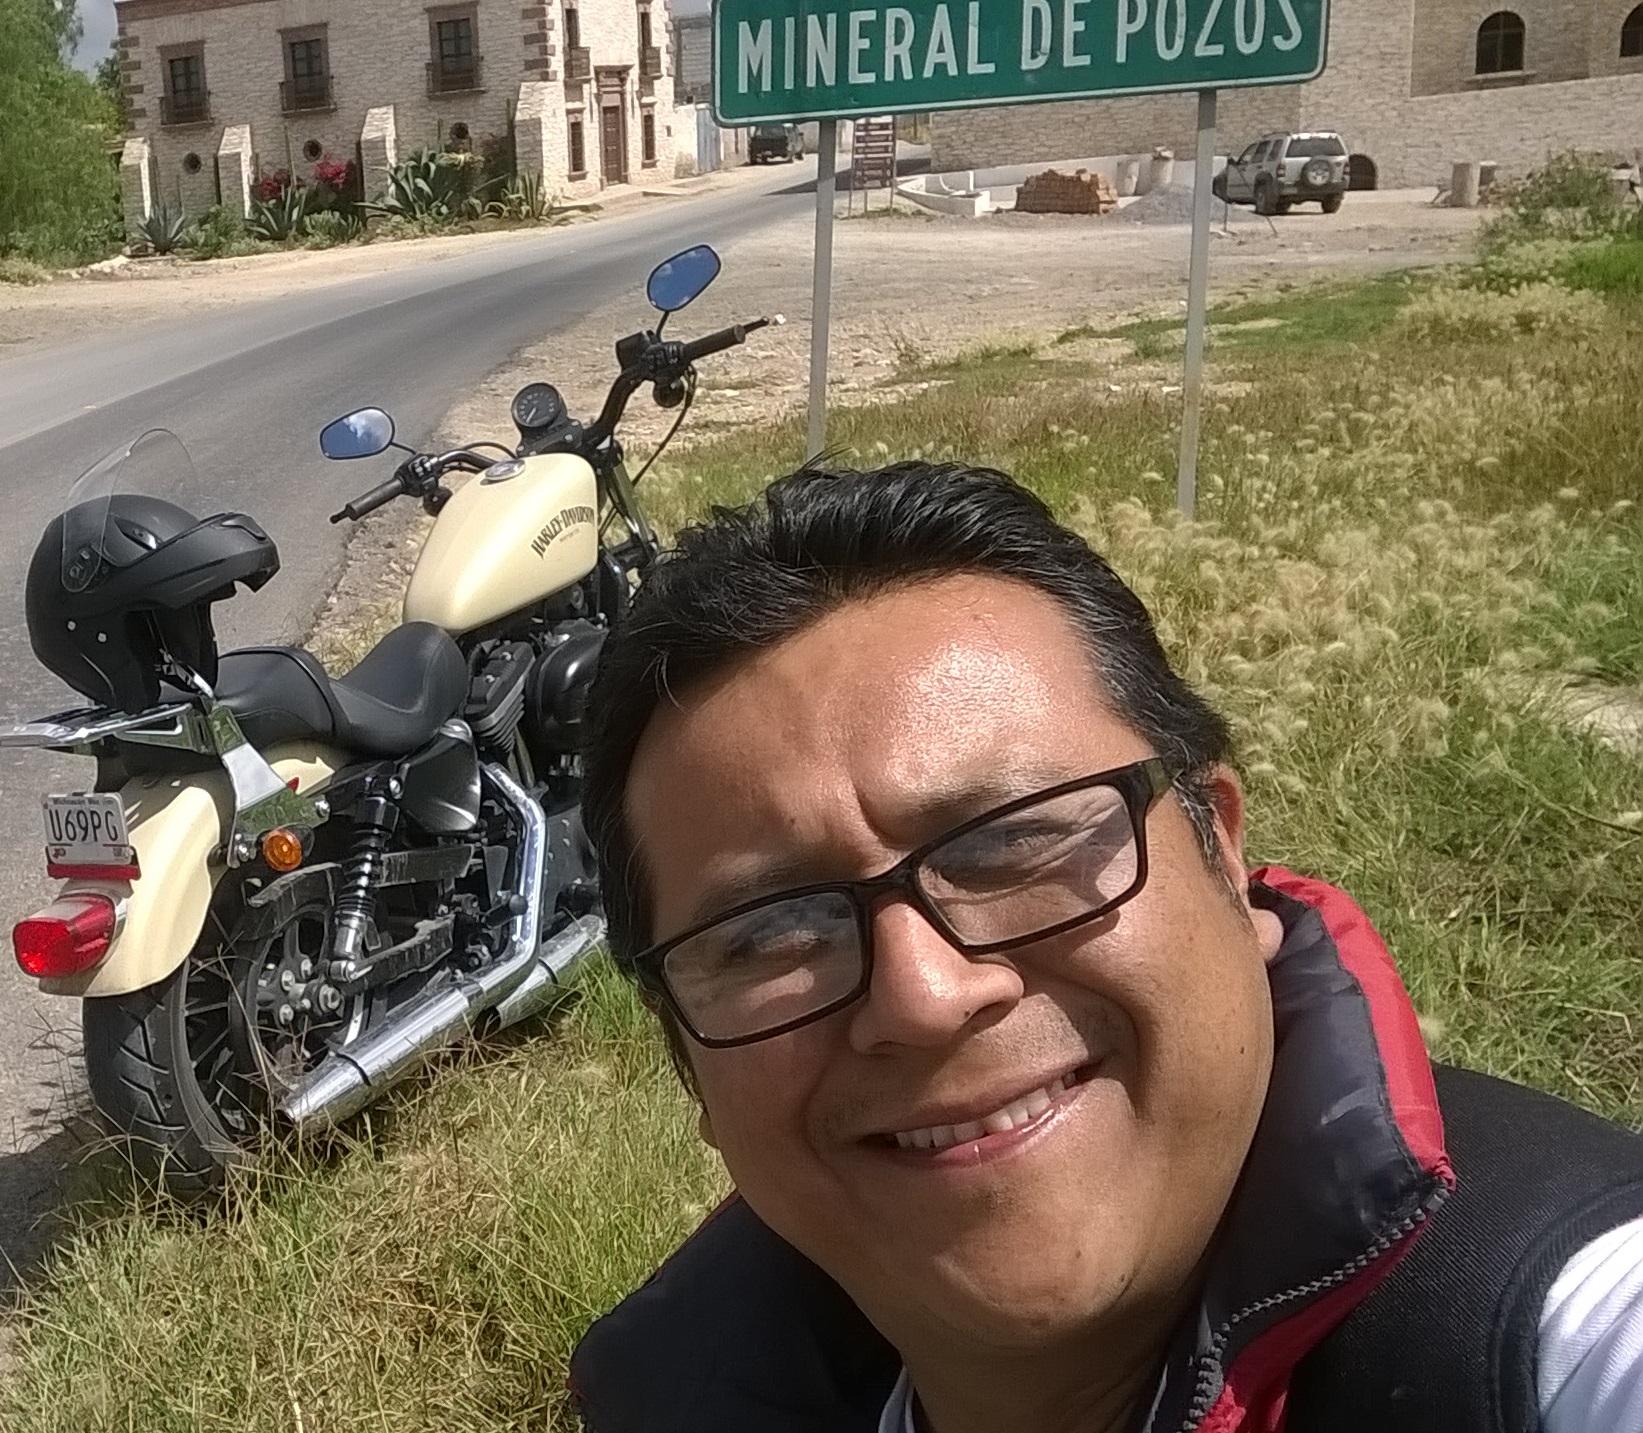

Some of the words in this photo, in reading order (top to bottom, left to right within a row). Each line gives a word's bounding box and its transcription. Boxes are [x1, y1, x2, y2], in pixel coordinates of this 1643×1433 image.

[738, 1, 996, 94] MINERAL
[1020, 0, 1091, 70] DE
[1115, 0, 1302, 63] POZOS
[48, 808, 119, 843] U69PG
